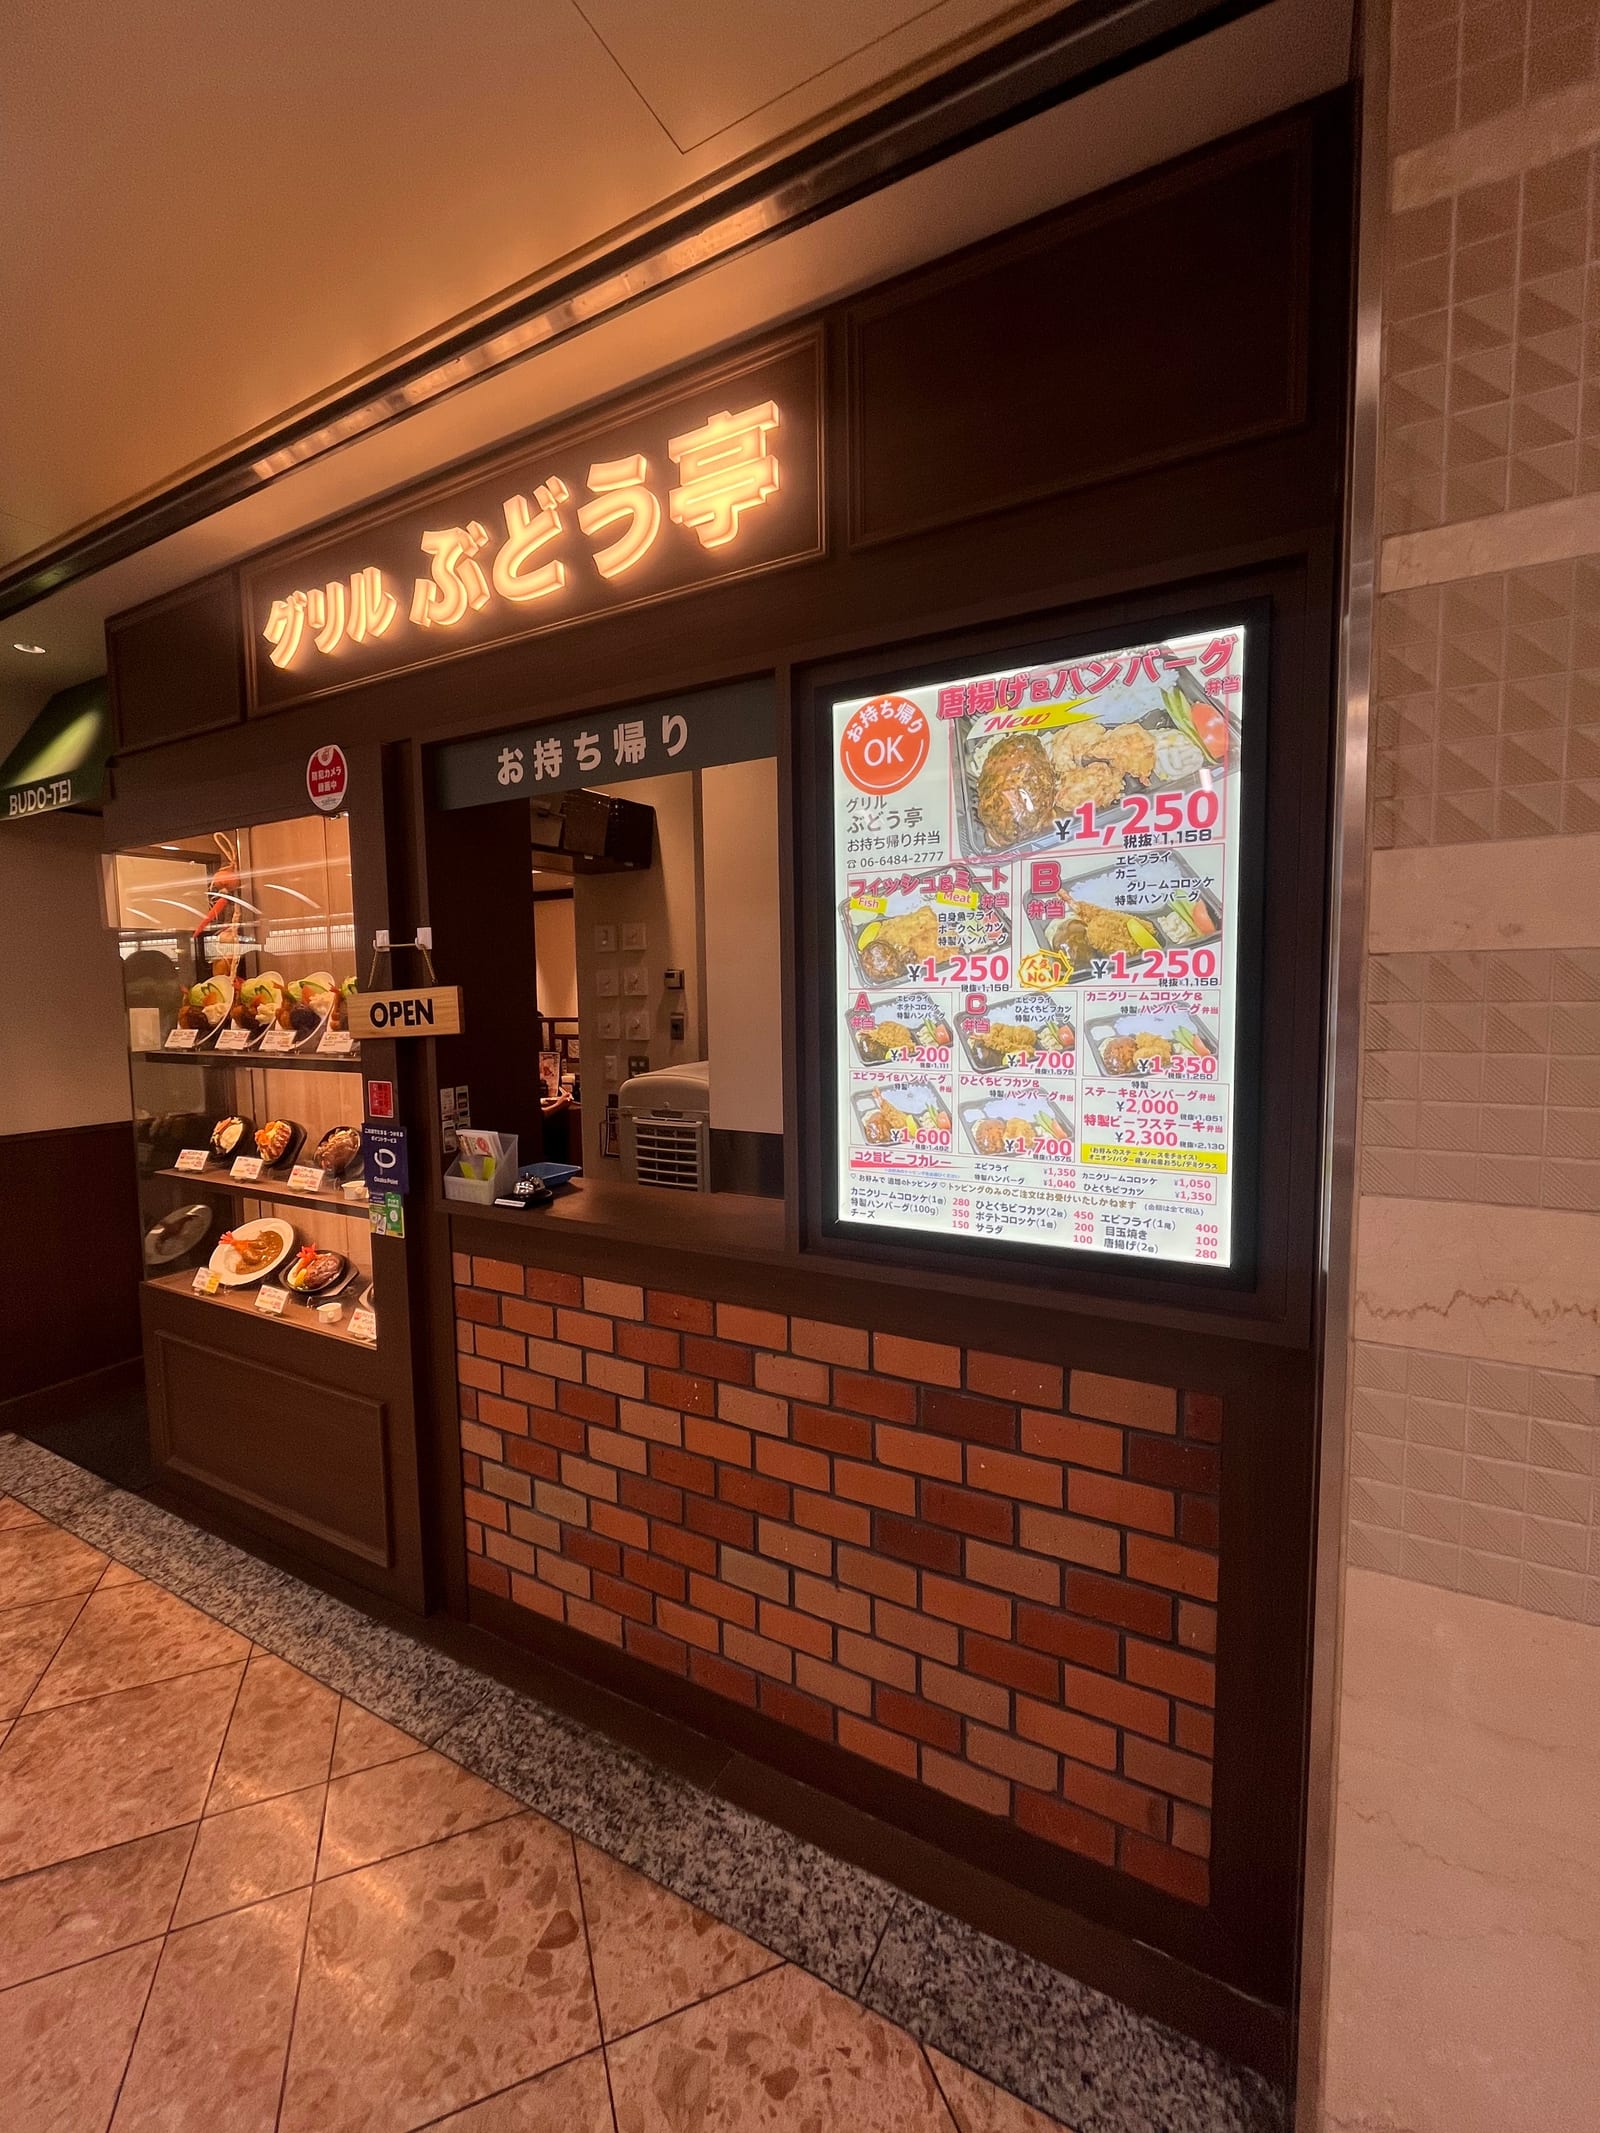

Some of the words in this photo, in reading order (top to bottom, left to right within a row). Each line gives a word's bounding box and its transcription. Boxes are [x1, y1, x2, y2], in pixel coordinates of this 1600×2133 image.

[263, 567, 397, 669] グリル
[409, 400, 780, 628] ぶどう亭
[936, 634, 1238, 720] 唐揚げ&ハンバーグ
[1204, 675, 1241, 697] 弁当
[847, 700, 923, 743] お持ち帰り
[984, 712, 1052, 733] New
[497, 714, 689, 786] お持ち帰り
[864, 735, 904, 767] OK
[9, 779, 71, 815] BUDO-TEI
[846, 795, 887, 813] グリル
[847, 807, 923, 834] ぶどう亭
[1055, 790, 1219, 846] ¥1,250
[847, 831, 941, 852] お持ち帰り弁当
[1123, 829, 1212, 848] 税抜¥1,158
[860, 851, 944, 868] 06-6484-2777
[1116, 852, 1171, 865] エビフライ
[849, 866, 1008, 897] フィッシュ&ミート
[1030, 861, 1062, 894] B
[1115, 869, 1136, 879] カニ
[1127, 877, 1214, 892] クリームコロッケ
[858, 897, 879, 909] Fish
[943, 891, 972, 904] Meat
[980, 892, 1009, 908] 弁当
[1114, 890, 1200, 906] 特製ハンバーグ
[938, 910, 994, 923] 白身魚フライ
[1028, 899, 1065, 919] 弁当
[938, 934, 1008, 946] 特製ハンバーグ
[908, 956, 1009, 985] ¥1,250
[1092, 949, 1216, 983] ¥1,250
[854, 991, 871, 1012] A
[965, 993, 987, 1014] C
[1086, 991, 1203, 1001] カニクリームコロッケ&
[369, 998, 434, 1028] OPEN
[1015, 1005, 1072, 1013] ひとくちビフカツ
[851, 1015, 876, 1029] 弁当
[961, 1018, 990, 1033] 弁当
[890, 1046, 949, 1063] ¥1,200
[1007, 1051, 1075, 1069] ¥1,700
[1138, 1055, 1216, 1075] ¥1,350
[960, 1076, 1040, 1088] ひとくちビフカツ&
[1116, 1098, 1179, 1115] ¥2,000
[891, 1128, 950, 1146] ¥1,600
[1115, 1130, 1178, 1146] ¥2,300
[1006, 1137, 1072, 1156] ¥1,700
[974, 1162, 1009, 1172] エビフライ
[1082, 1172, 1158, 1185] カニクリームコロッケ
[1083, 1183, 1144, 1196] ひとくちビフカツ
[952, 1197, 970, 1207] 280
[851, 1208, 875, 1219] チーズ
[952, 1220, 970, 1229] 150
[952, 1209, 970, 1218] 350
[1073, 1210, 1094, 1220] 450
[976, 1223, 1004, 1235] サラダ
[1073, 1235, 1093, 1245] 100
[1074, 1223, 1094, 1233] 200
[1105, 1226, 1148, 1240] 目玉焼き
[1196, 1236, 1218, 1247] 100
[1195, 1223, 1218, 1234] 400
[1195, 1248, 1217, 1260] 280
